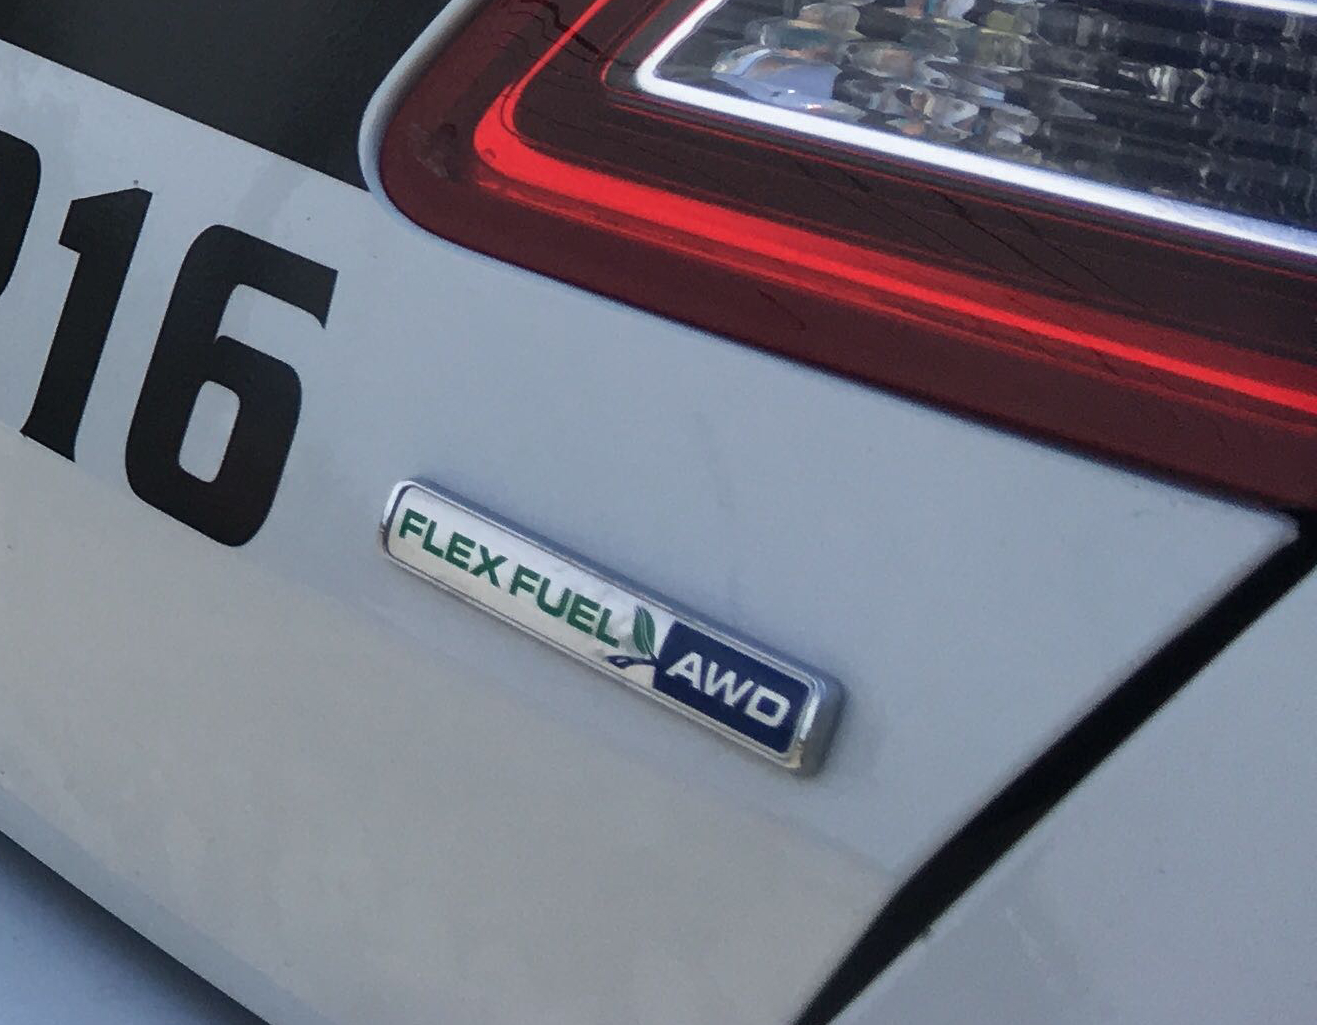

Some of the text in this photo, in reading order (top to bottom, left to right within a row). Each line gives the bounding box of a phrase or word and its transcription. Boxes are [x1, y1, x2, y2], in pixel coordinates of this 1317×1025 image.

[398, 507, 791, 729] FLEX FUEL AWD
